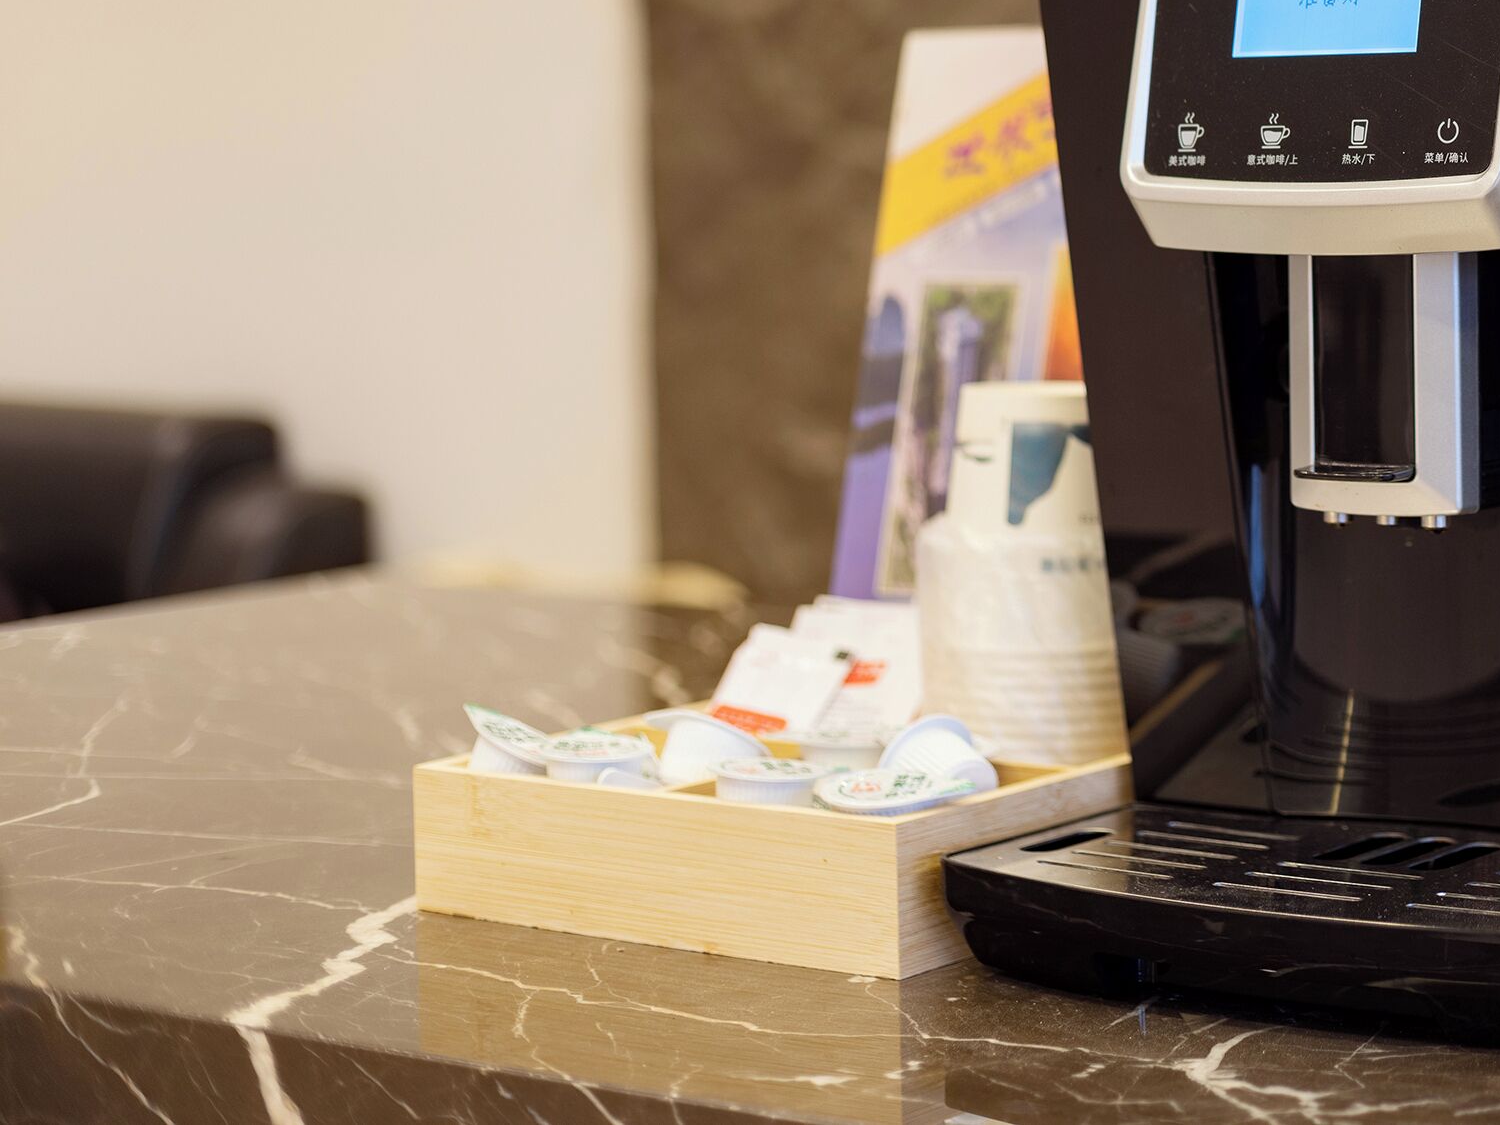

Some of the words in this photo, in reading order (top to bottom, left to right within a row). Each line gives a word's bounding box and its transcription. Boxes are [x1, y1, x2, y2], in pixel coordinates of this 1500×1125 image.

[1341, 153, 1376, 165] 热水/下
[1424, 152, 1469, 165] 菜单/确认
